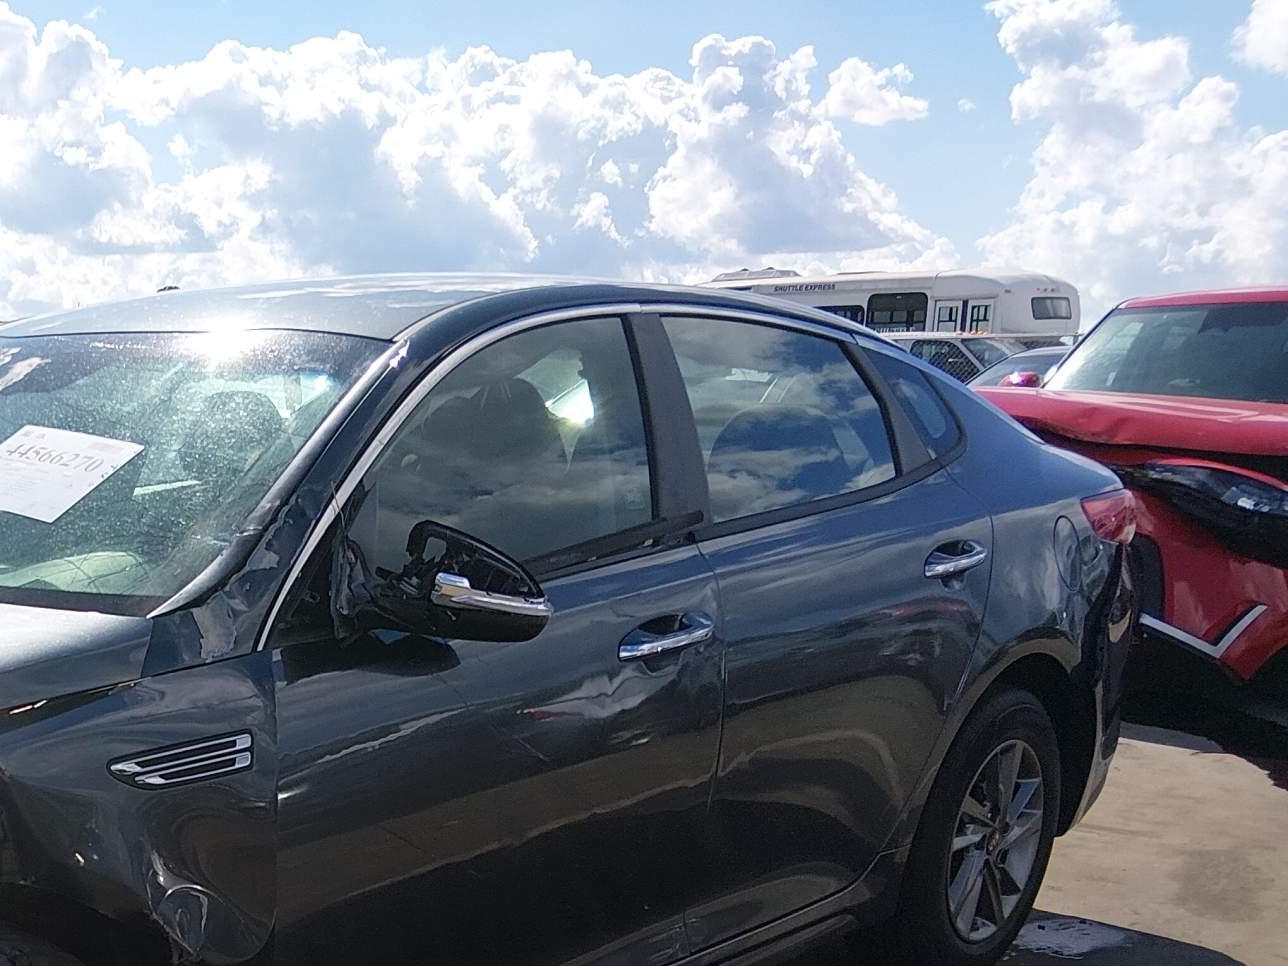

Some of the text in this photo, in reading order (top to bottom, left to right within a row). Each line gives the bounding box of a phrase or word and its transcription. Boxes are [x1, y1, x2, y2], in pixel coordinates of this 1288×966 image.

[774, 283, 836, 292] SHUTTLE EXPRESS
[7, 443, 105, 473] 44566270
